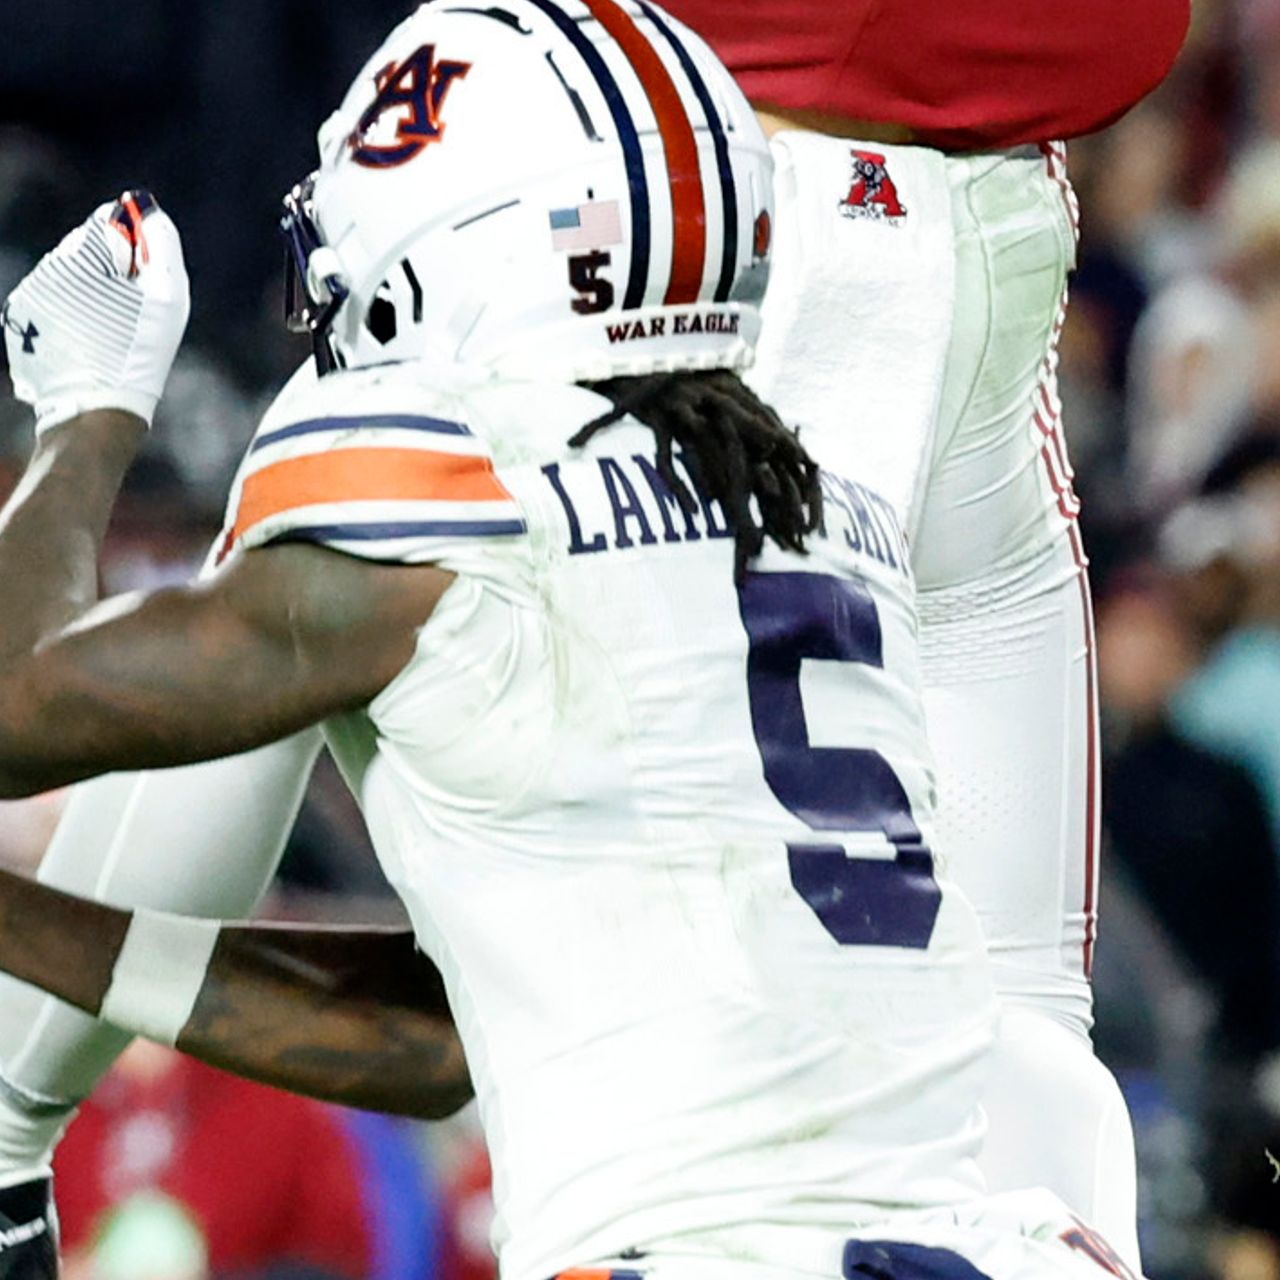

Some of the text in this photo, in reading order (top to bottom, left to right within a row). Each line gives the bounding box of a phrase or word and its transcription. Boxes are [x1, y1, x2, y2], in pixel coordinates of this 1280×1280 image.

[569, 252, 615, 315] 5
[605, 313, 740, 344] WAR EAGLE
[737, 570, 943, 950] 5
